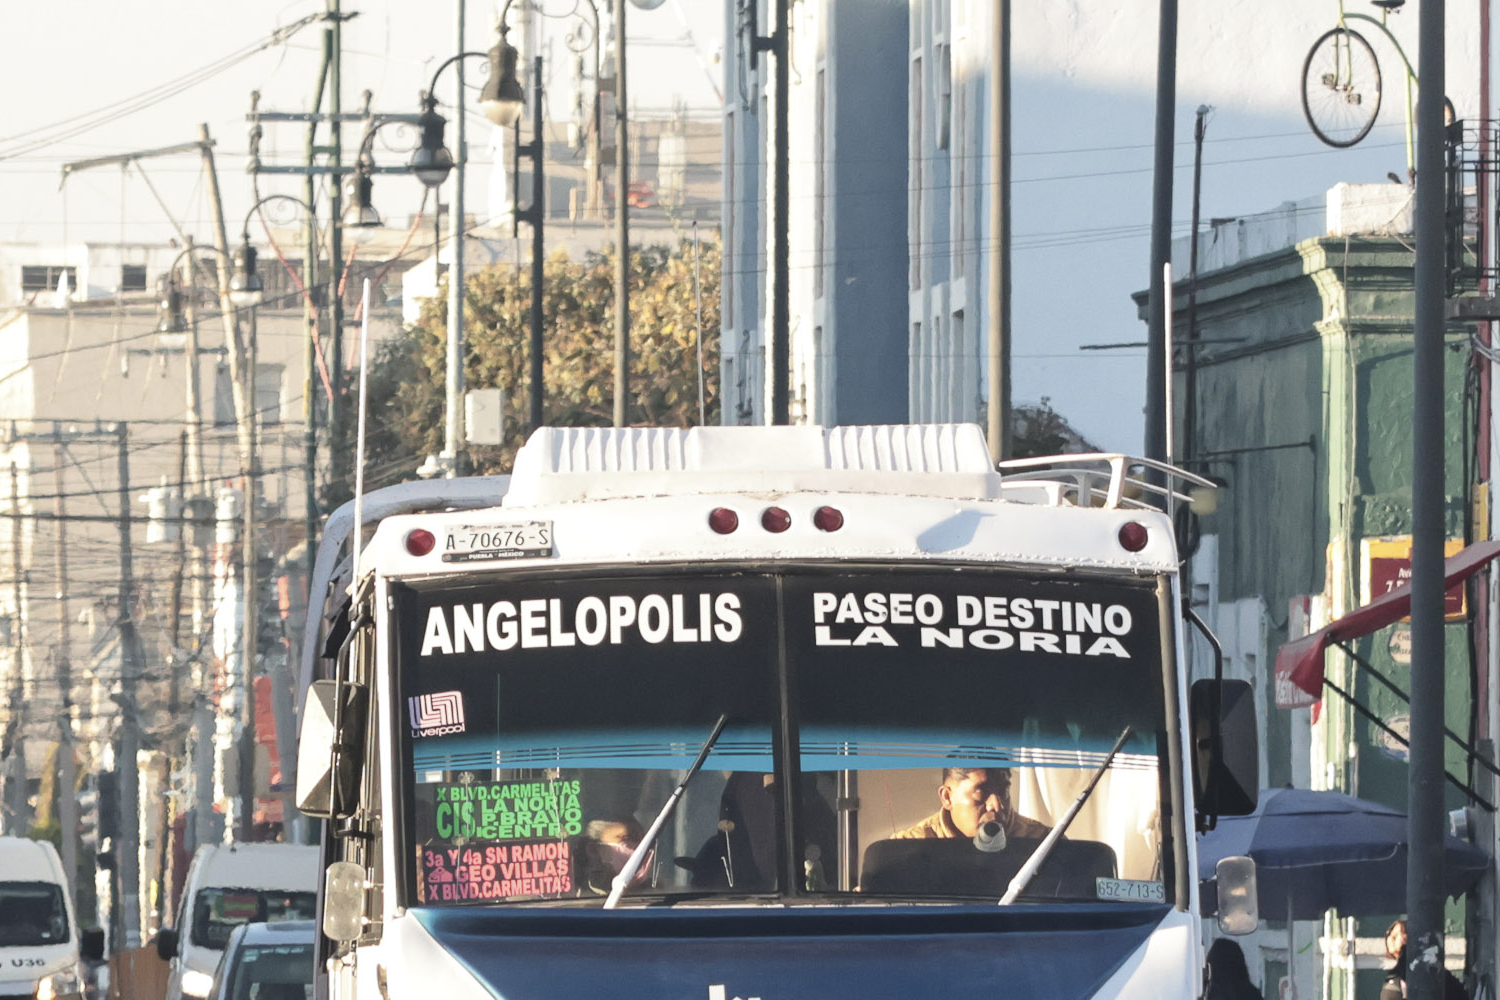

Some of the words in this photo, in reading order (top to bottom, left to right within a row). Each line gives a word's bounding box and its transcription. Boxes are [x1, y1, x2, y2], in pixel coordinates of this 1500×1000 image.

[445, 529, 549, 551] A-70676-S
[420, 592, 743, 657] ANGELOPOLIS
[813, 592, 943, 625] PASEO
[957, 595, 1133, 636] DESTINO
[814, 626, 899, 647] LA
[920, 627, 1132, 659] NORIA
[436, 788, 447, 802] X
[450, 780, 581, 801] BLVD.CARMELITAS
[481, 798, 507, 815] LA
[514, 795, 581, 813] NORIA
[481, 808, 582, 827] P.BRAVO
[483, 822, 582, 839] CENTRO
[425, 851, 444, 867] 3a
[447, 850, 459, 866] Y
[462, 848, 483, 865] 4a
[485, 846, 508, 864] SN
[511, 842, 569, 863] RAMON
[455, 864, 496, 882] GEO
[500, 859, 569, 880] VILLAS
[428, 884, 440, 900] X
[442, 876, 571, 900] BLVD.CARMELITAS
[11, 958, 46, 968] U36
